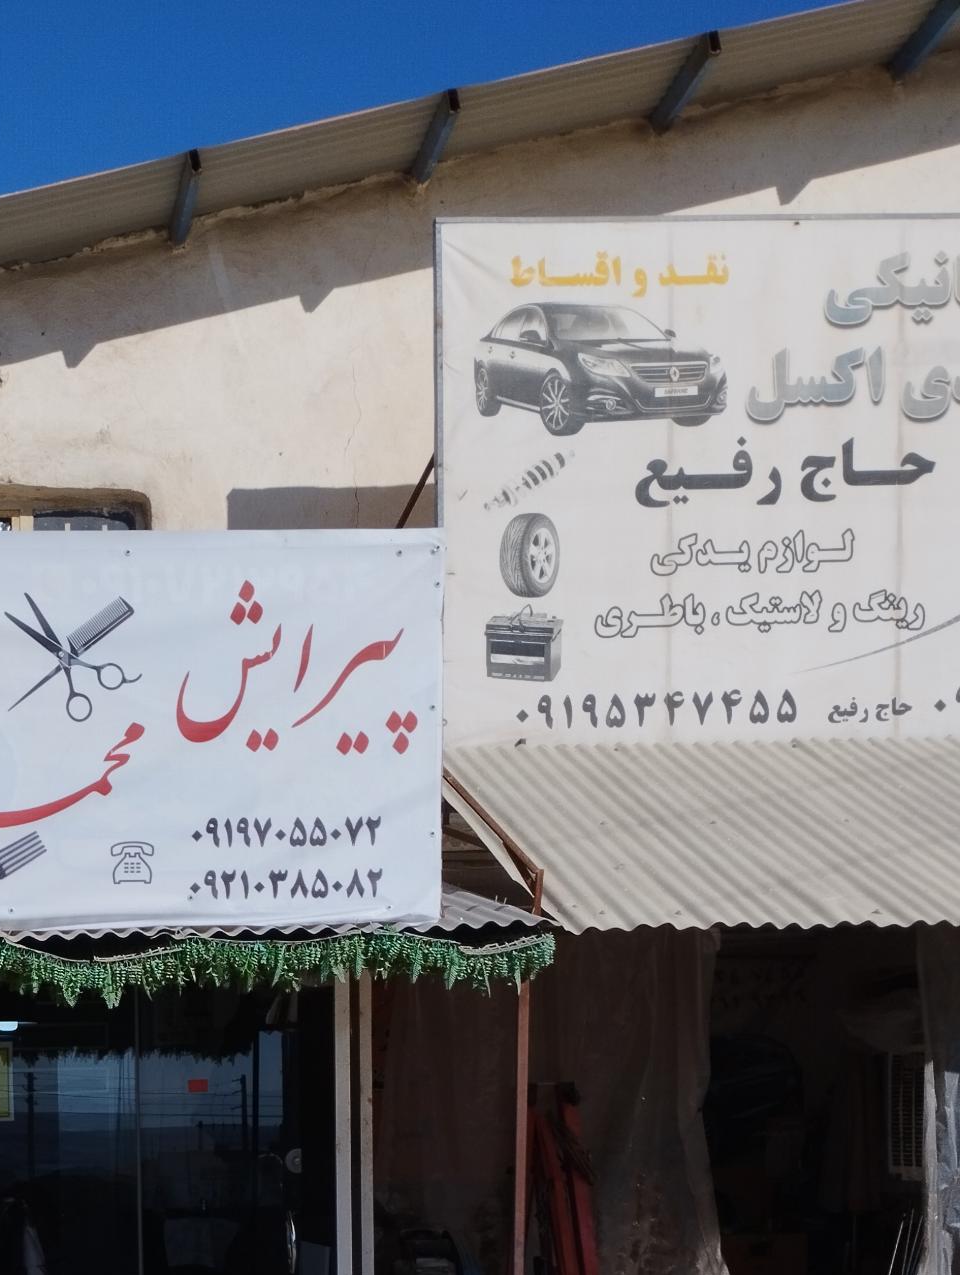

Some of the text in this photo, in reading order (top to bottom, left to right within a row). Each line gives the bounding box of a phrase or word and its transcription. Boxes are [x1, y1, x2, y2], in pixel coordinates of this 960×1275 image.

[510, 250, 730, 298] نقد و اقساط
[745, 345, 886, 421] اکسل
[635, 436, 937, 508] حاج رفیع
[650, 527, 856, 577] لوازم یدکی
[593, 592, 706, 638] باطری
[827, 601, 847, 632] و
[852, 589, 926, 631] رینگ
[176, 579, 419, 756] پیرایش
[515, 688, 798, 730] ۰۹۱۹۵۳۴۷۴۵۵
[826, 696, 870, 724] رفیع
[874, 696, 914, 722] حاج
[191, 815, 383, 849] ۰۹۱۹۷۰۵۵۰۷۲
[190, 867, 384, 900] ۰۹۲۱۰۳۸۵۰۸۲
